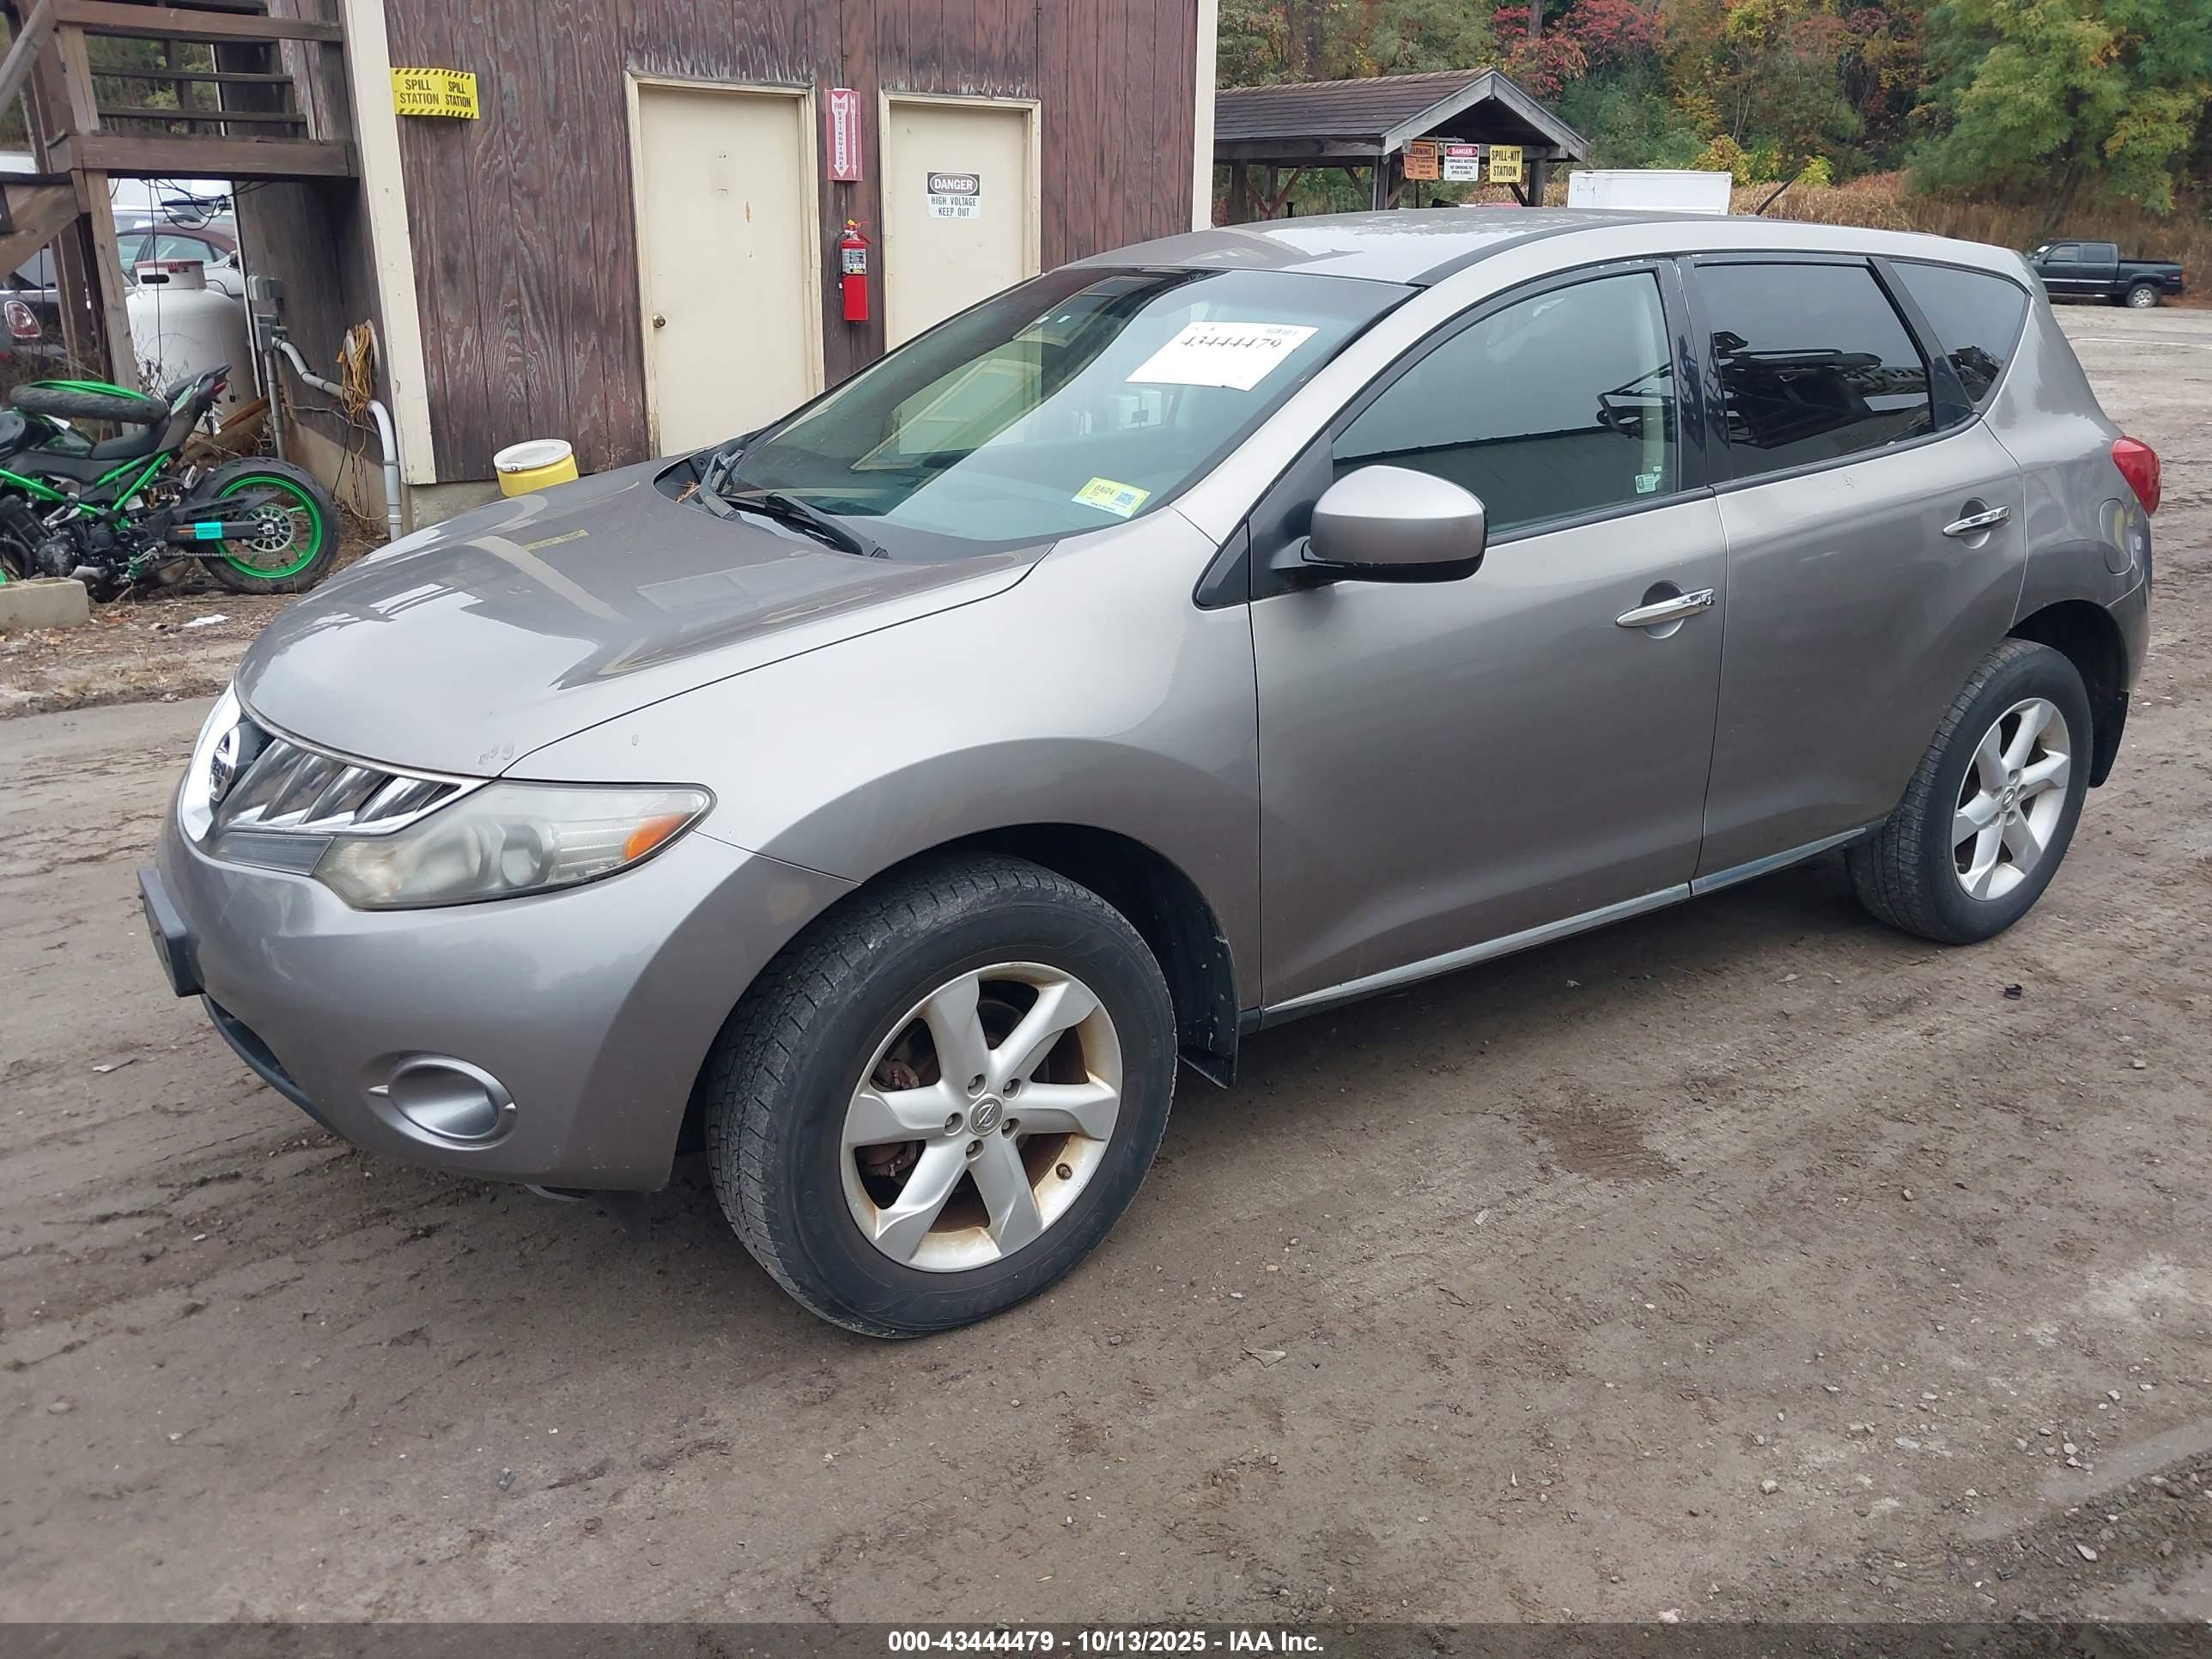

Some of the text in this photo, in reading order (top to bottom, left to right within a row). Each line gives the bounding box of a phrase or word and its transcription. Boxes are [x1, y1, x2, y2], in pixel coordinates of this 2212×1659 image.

[404, 79, 432, 90] SPILL
[447, 81, 466, 94] SPILL
[399, 93, 440, 105] STATION
[445, 94, 471, 108] STATION
[1491, 150, 1520, 162] SPILL-KIT
[1492, 166, 1517, 177] STATION
[934, 178, 973, 191] DANGER
[931, 196, 976, 206] HIGH VOLTAGE
[938, 207, 970, 217] KEEP OUT
